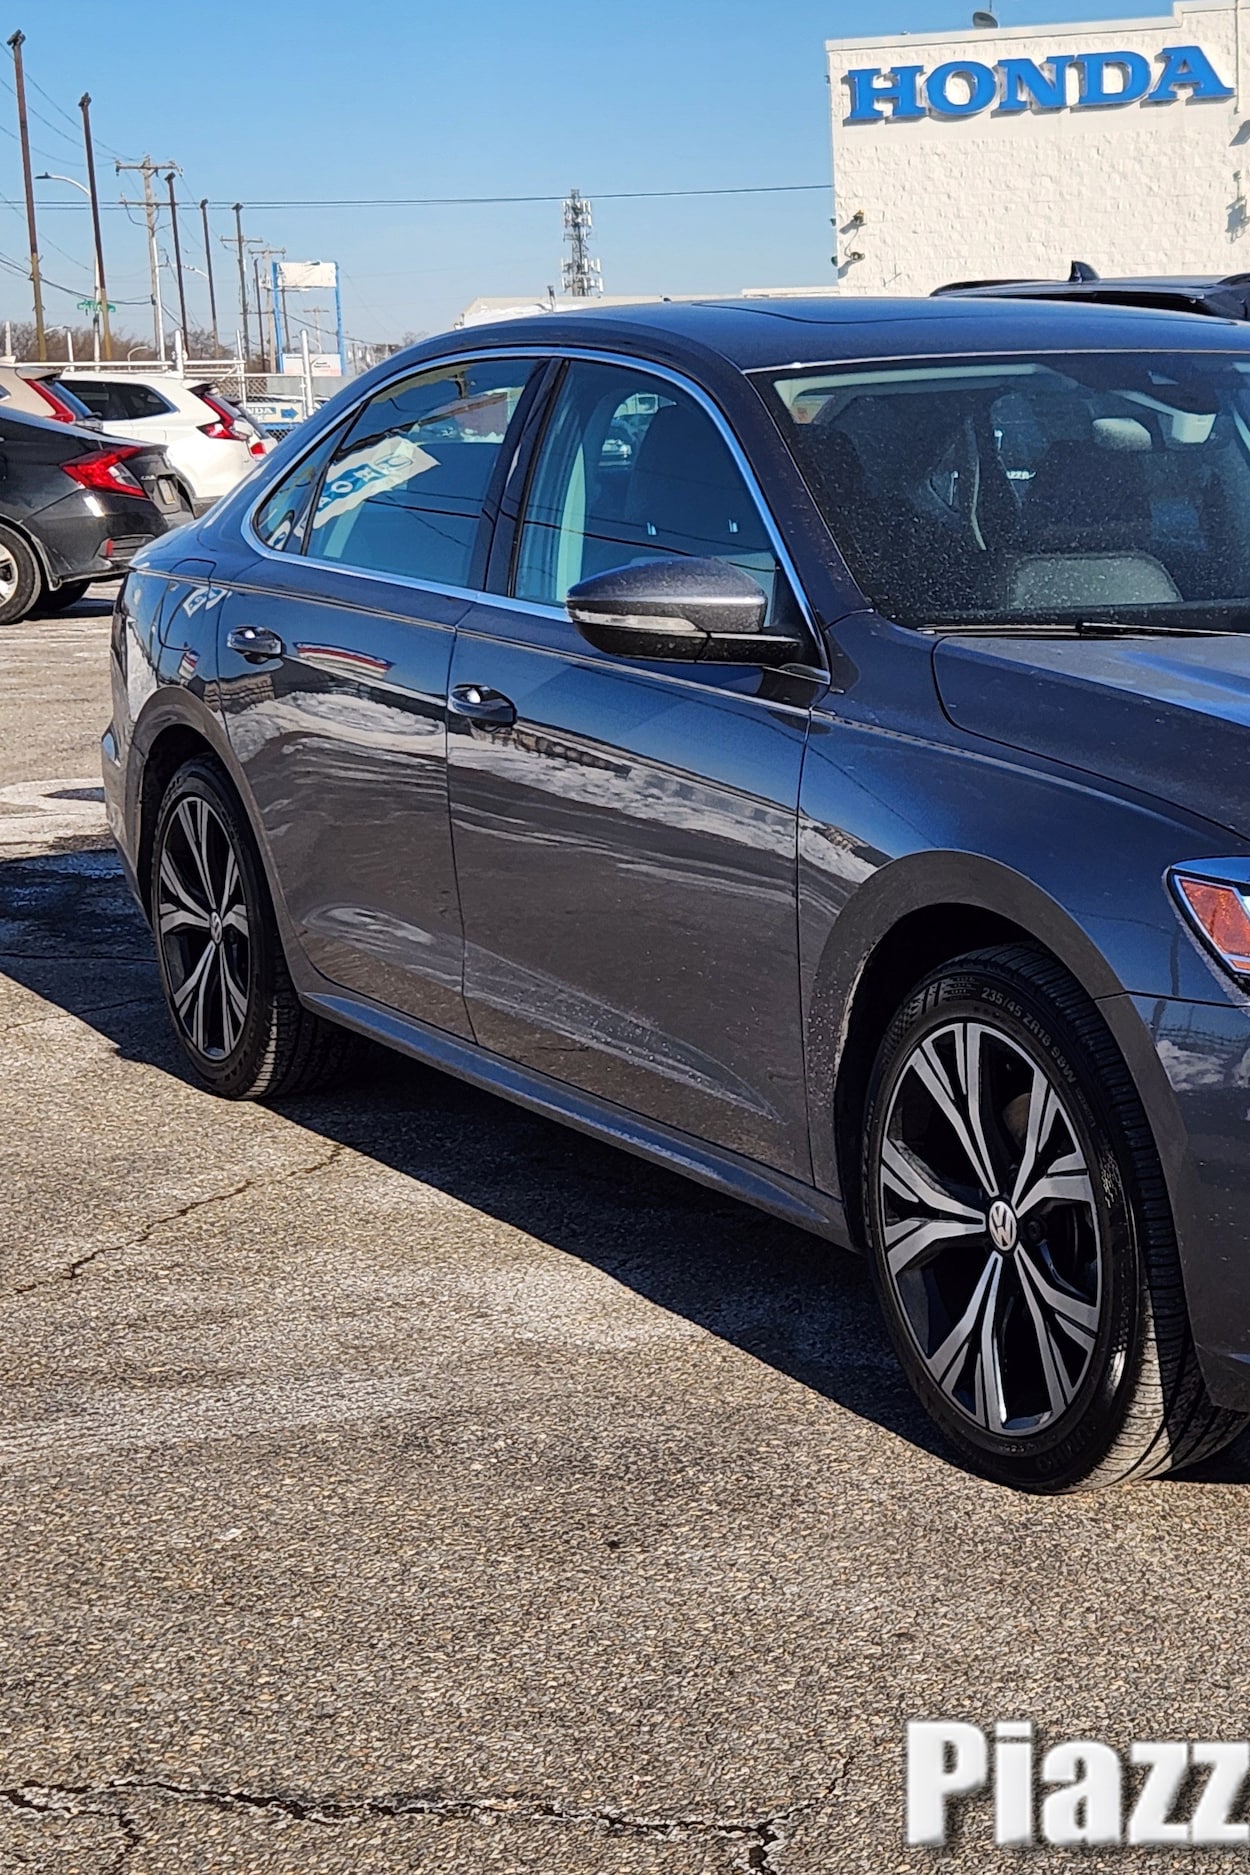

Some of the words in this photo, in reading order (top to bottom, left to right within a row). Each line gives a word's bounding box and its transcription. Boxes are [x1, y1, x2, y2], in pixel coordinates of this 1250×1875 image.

[847, 45, 1235, 121] HONDA
[980, 986, 1022, 1017] 235/45
[1022, 1012, 1053, 1047] ZR18
